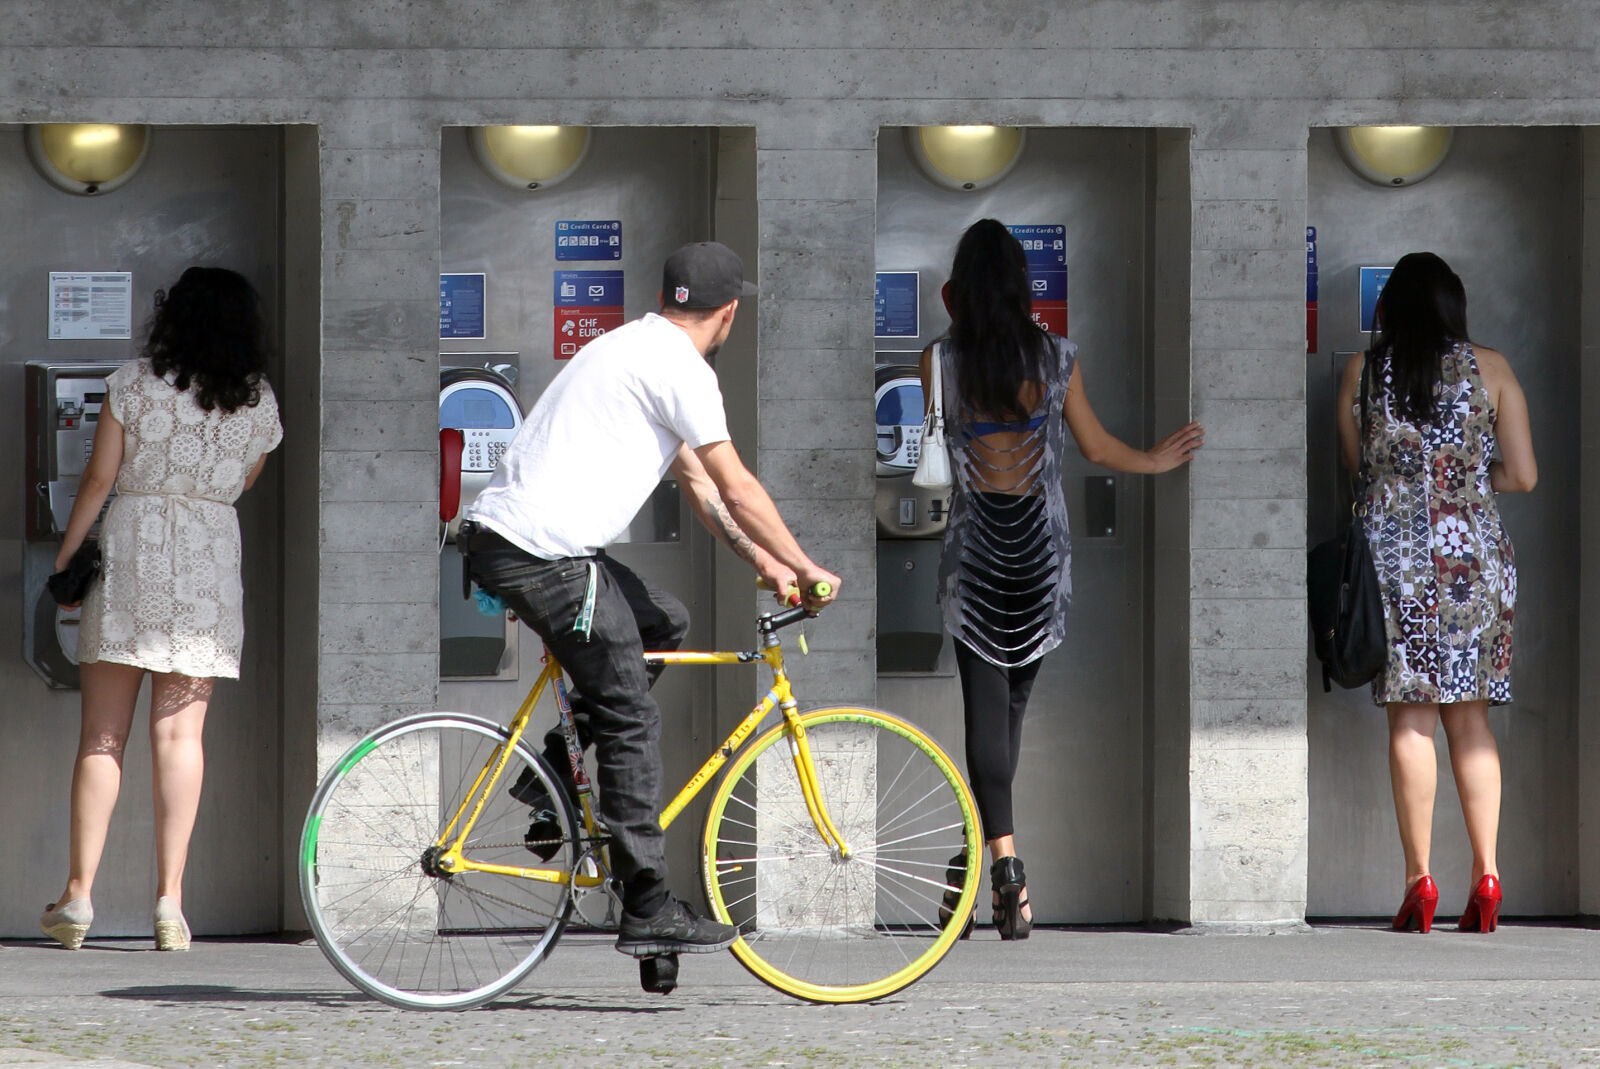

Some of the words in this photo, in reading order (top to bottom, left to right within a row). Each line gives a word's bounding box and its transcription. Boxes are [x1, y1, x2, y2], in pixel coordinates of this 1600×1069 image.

[1014, 226, 1034, 234] Credit
[1036, 226, 1054, 234] Cards
[579, 318, 598, 327] CHF
[579, 328, 605, 337] EURO
